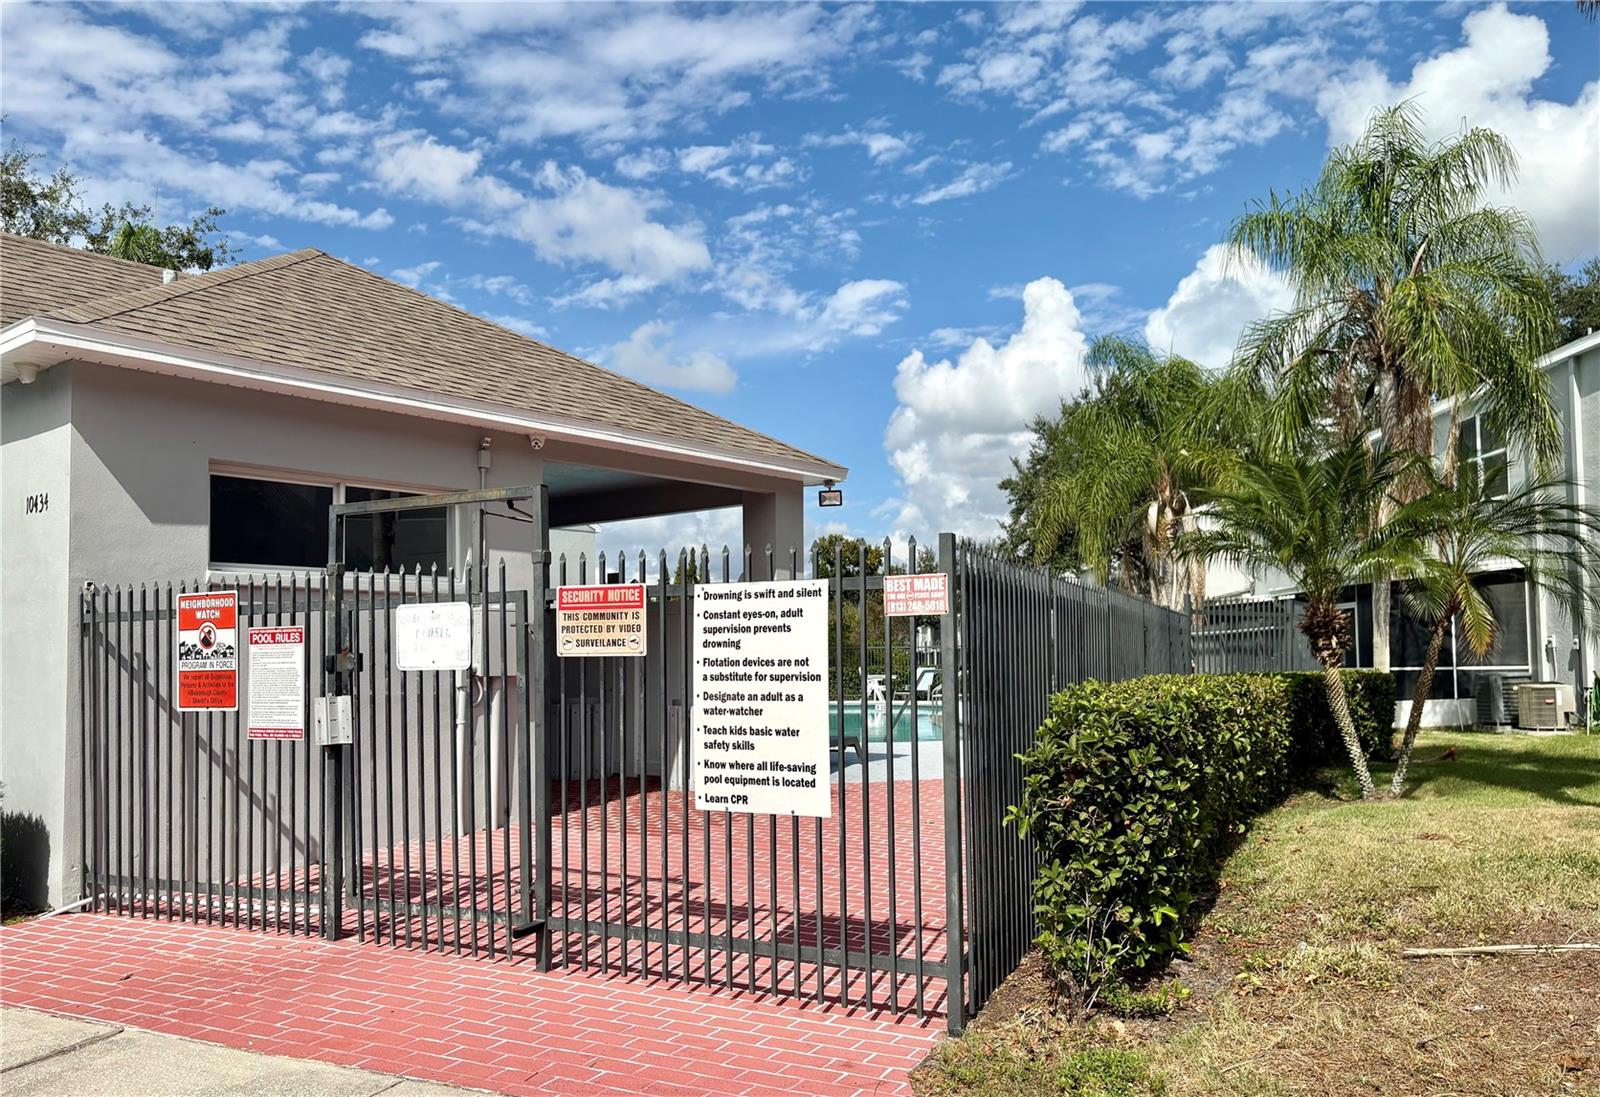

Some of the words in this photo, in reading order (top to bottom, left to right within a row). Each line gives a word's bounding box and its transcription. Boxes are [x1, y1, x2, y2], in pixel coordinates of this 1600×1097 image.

[26, 492, 48, 514] 10434
[886, 578, 912, 592] BEST
[914, 577, 944, 591] MADE
[562, 590, 604, 603] SECURITY
[608, 588, 640, 601] NOTICE
[703, 590, 742, 601] Drowning
[744, 590, 752, 600] is
[754, 588, 775, 599] swift
[778, 588, 794, 598] and
[796, 587, 822, 598] silent
[180, 598, 234, 609] NEIGHBORHOOD
[887, 601, 906, 612] (813)
[196, 610, 220, 619] WATCH
[563, 612, 580, 621] THIS
[582, 612, 629, 621] COMMUNITY
[632, 611, 640, 620] IS
[703, 610, 740, 620] Constant
[742, 610, 778, 620] eyes-on,
[780, 608, 803, 618] adult
[561, 624, 603, 633] PROTECTED
[606, 624, 615, 633] BY
[619, 624, 641, 632] VIDEO
[703, 624, 751, 635] supervision
[754, 623, 791, 635] prevents
[252, 634, 273, 644] POOL
[275, 632, 300, 643] RULES
[576, 639, 626, 647] SURVEILANCE
[703, 639, 741, 650] drowning
[703, 657, 740, 667] Flotation
[742, 657, 775, 666] devices
[777, 658, 792, 666] are
[794, 657, 809, 666] not
[710, 672, 752, 681] substitute
[755, 672, 767, 681] for
[770, 672, 821, 683] supervision
[703, 692, 745, 703] Designate
[760, 692, 783, 701] adult
[785, 693, 795, 701] as
[703, 707, 763, 716] water-watcher
[703, 725, 727, 735] Teach
[730, 726, 747, 736] kids
[750, 726, 772, 736] basic
[775, 728, 800, 737] water
[704, 740, 730, 751] safety
[732, 740, 755, 750] skills
[704, 760, 726, 769] Know
[729, 760, 754, 770] where
[757, 761, 767, 771] all
[770, 761, 816, 775] life-saving
[704, 775, 722, 785] pool
[724, 775, 770, 786] equipment
[772, 777, 780, 786] is
[782, 777, 816, 788] located
[705, 794, 729, 803] Learn
[731, 795, 748, 804] CPR
